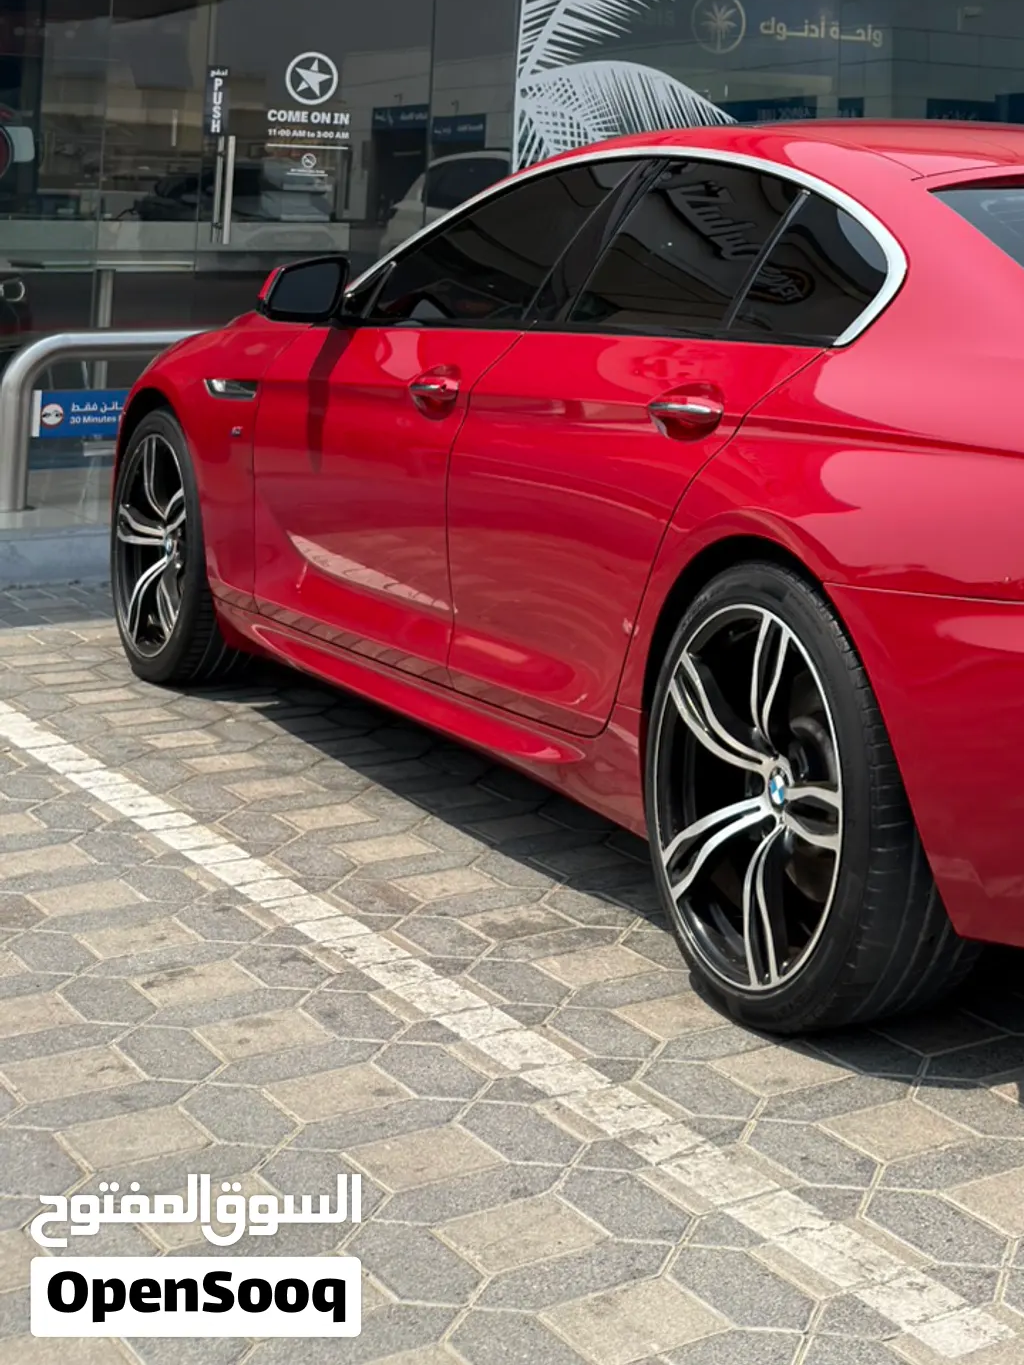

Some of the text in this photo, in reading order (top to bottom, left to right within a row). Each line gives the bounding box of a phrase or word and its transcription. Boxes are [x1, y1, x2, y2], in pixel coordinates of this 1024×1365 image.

[759, 14, 883, 48] واحة أدنوك
[210, 77, 224, 133] PUSH
[267, 109, 350, 125] COME ON IN
[292, 129, 306, 137] AM
[307, 130, 316, 138] to
[335, 131, 350, 139] AM
[71, 401, 98, 413] فقط
[70, 415, 81, 425] 30
[82, 414, 117, 424] Minutes
